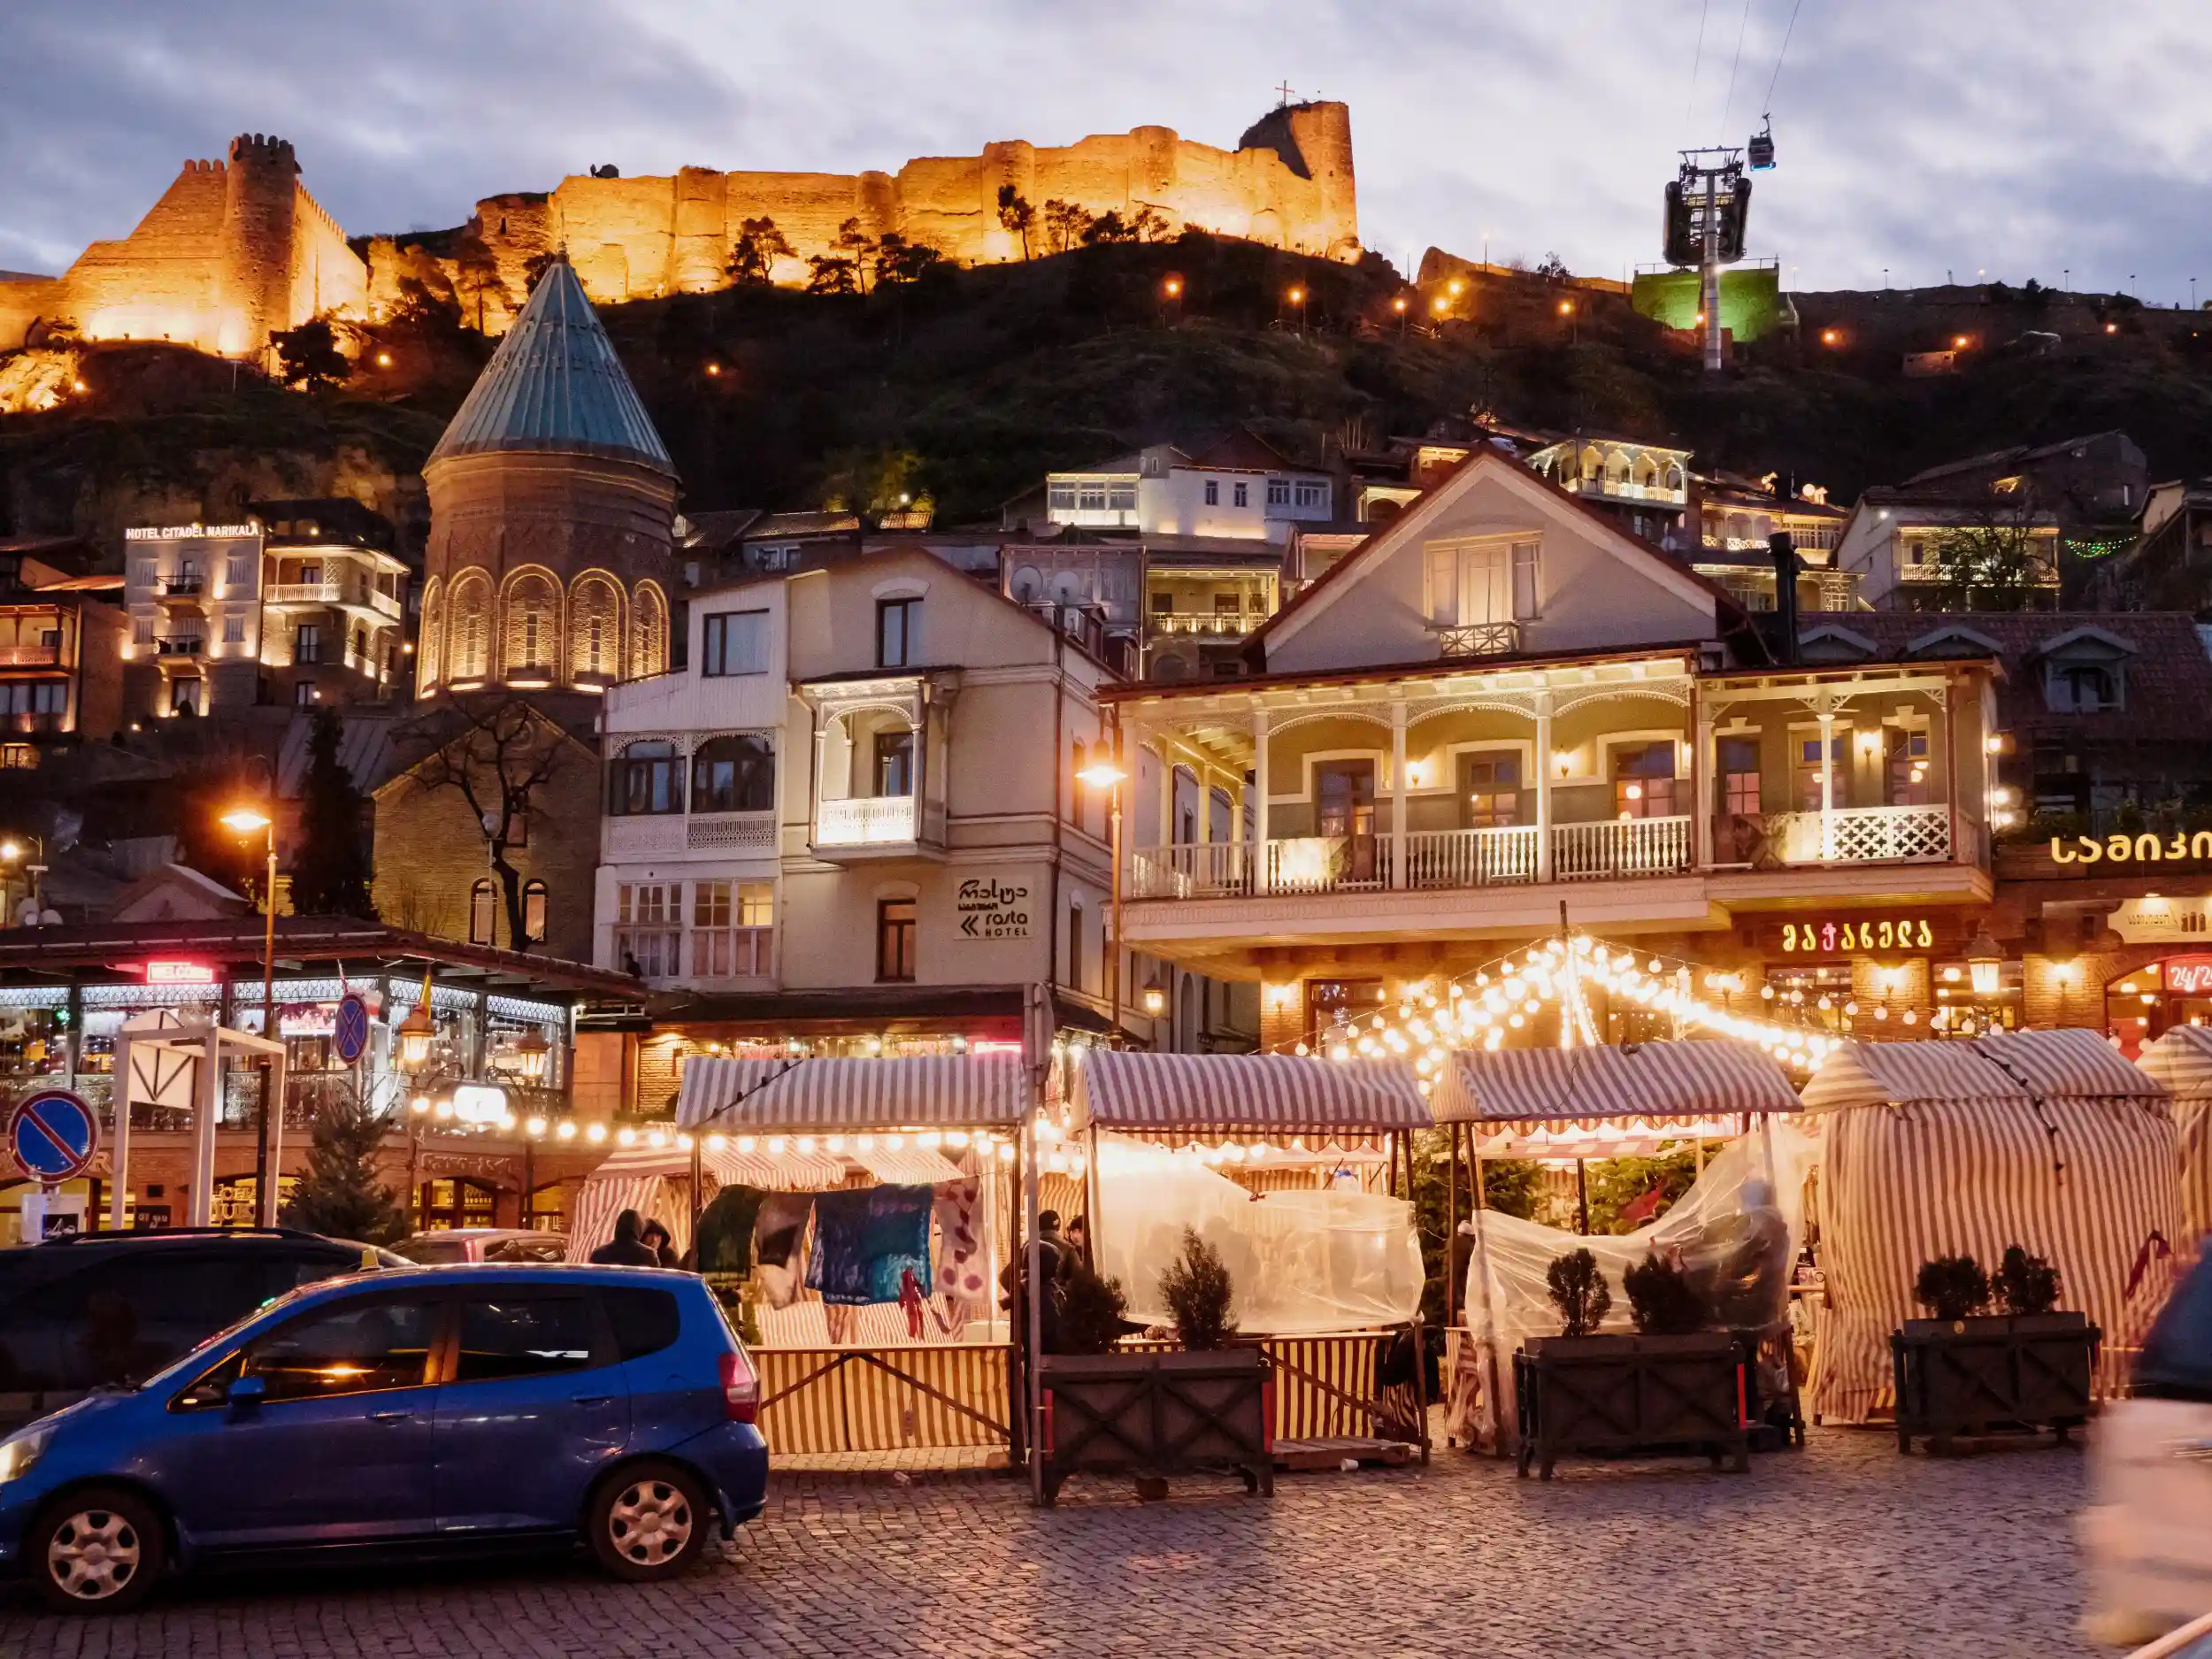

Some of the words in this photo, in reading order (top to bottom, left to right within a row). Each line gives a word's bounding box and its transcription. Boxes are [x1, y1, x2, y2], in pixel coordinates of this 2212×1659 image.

[126, 527, 160, 540] HOTEL
[162, 526, 205, 539] CITADEL
[207, 526, 259, 537] NARIKALA
[986, 910, 1028, 926] rasta
[985, 927, 1028, 937] HOTEL
[2170, 965, 2212, 991] 24/2
